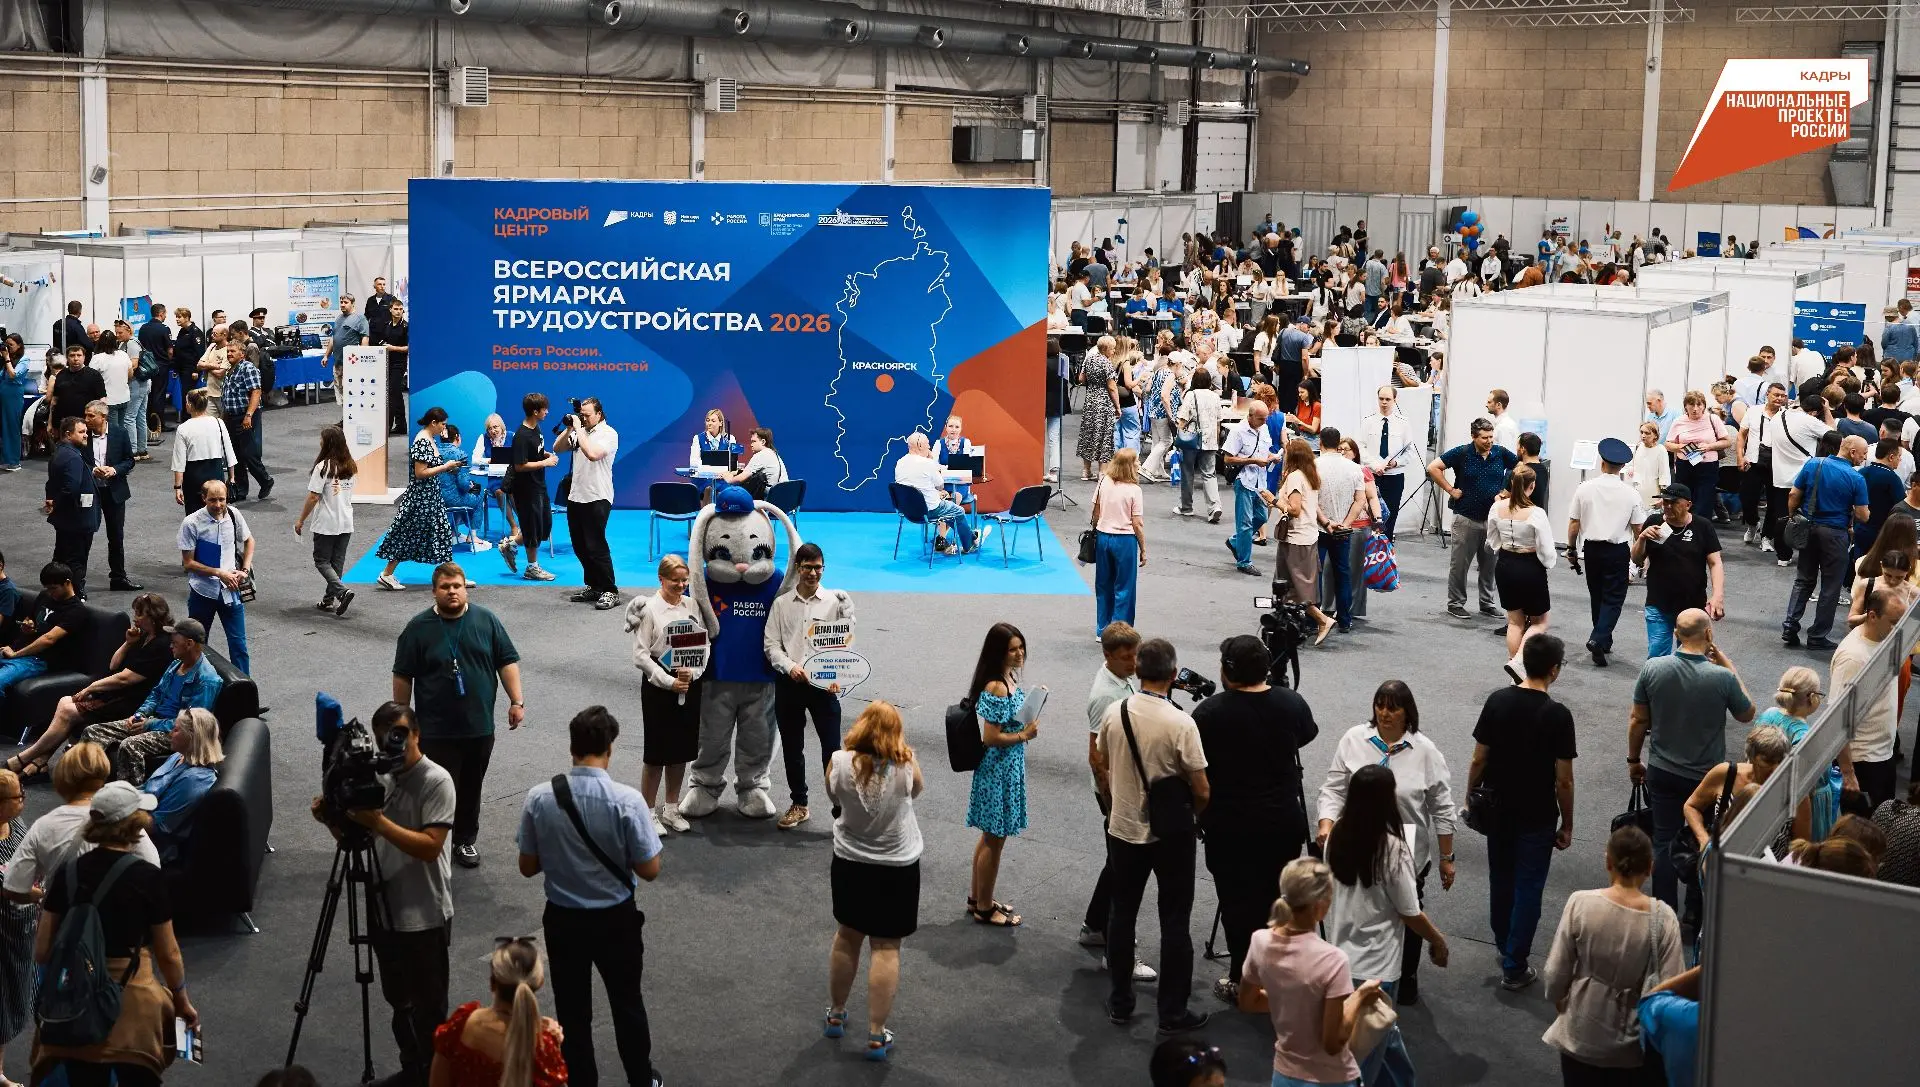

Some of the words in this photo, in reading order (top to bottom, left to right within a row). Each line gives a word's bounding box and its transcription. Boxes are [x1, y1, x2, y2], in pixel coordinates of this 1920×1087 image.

[494, 206, 589, 221] КАДРОВЫЙ
[630, 211, 654, 219] КАДРЫ
[818, 216, 837, 224] 2026
[494, 223, 548, 238] ЦЕНТР
[494, 257, 731, 282] ВСЕРОССИЙСКАЯ
[494, 284, 626, 305] ЯРМАРКА
[492, 307, 763, 333] ТРУДОУСТРОЙСТВА
[771, 313, 831, 333] 2026
[492, 345, 542, 356] Работа
[546, 345, 602, 357] России.
[492, 359, 539, 372] Время
[543, 360, 649, 372] возможностей
[852, 361, 918, 371] КРАСНОЯРСК
[733, 601, 764, 609] РАБОТА
[733, 609, 766, 617] РОССИИ
[814, 625, 832, 635] ДЕЛАЮ
[832, 624, 850, 634] ЛЮДЕЙ
[813, 636, 845, 647] СЧАСТЛИВЕЕ
[680, 655, 705, 668] УСПЕХ
[820, 672, 836, 680] ЦЕНТР
